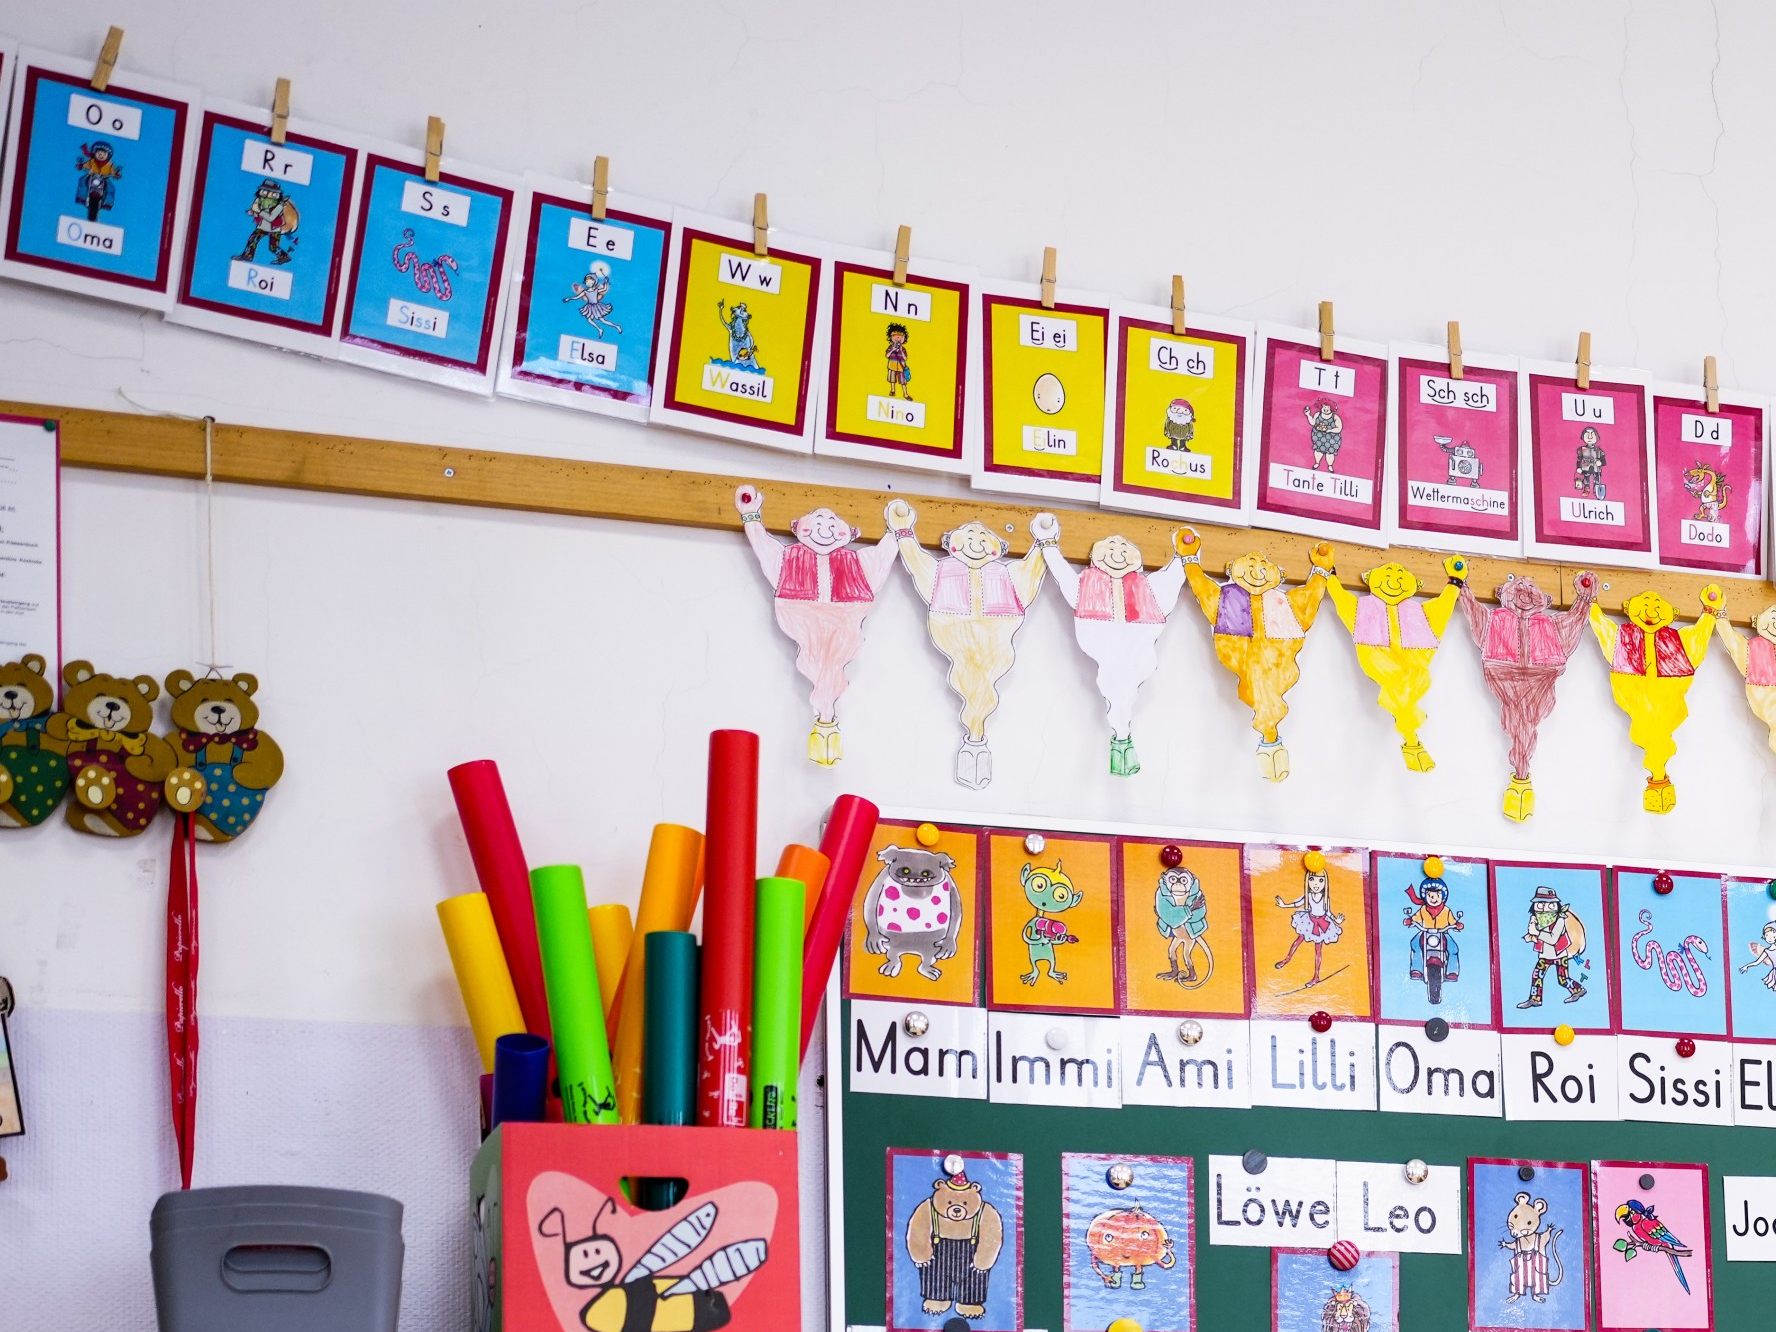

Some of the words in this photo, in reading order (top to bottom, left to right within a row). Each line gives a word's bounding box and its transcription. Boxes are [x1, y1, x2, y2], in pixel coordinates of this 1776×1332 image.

[67, 222, 113, 249] Oma
[247, 269, 274, 292] Roi
[399, 305, 437, 332] Sissi
[1031, 322, 1045, 342] Ei
[1053, 327, 1066, 344] ei
[571, 340, 605, 365] Elsa
[1157, 346, 1178, 366] Ch
[1187, 352, 1205, 371] ch
[709, 368, 767, 398] Wassil
[1427, 380, 1456, 400] Sch
[1464, 386, 1489, 405] sch
[878, 400, 914, 422] Nino
[1152, 450, 1205, 474] Rochus
[1284, 469, 1324, 492] Tante
[1331, 477, 1358, 498] Tilli
[1411, 486, 1505, 509] Wettermaschine
[1572, 502, 1614, 521] Ulrich
[1689, 524, 1722, 543] Dodo
[996, 1030, 1113, 1089] Immi
[1136, 1032, 1233, 1089] Ami
[1271, 1035, 1355, 1092] Lilli
[1385, 1041, 1495, 1099] Oma
[1531, 1050, 1596, 1104] Roi
[1629, 1052, 1721, 1108] Sissi
[1217, 1173, 1330, 1228] Löwe
[1363, 1181, 1436, 1234] Leo
